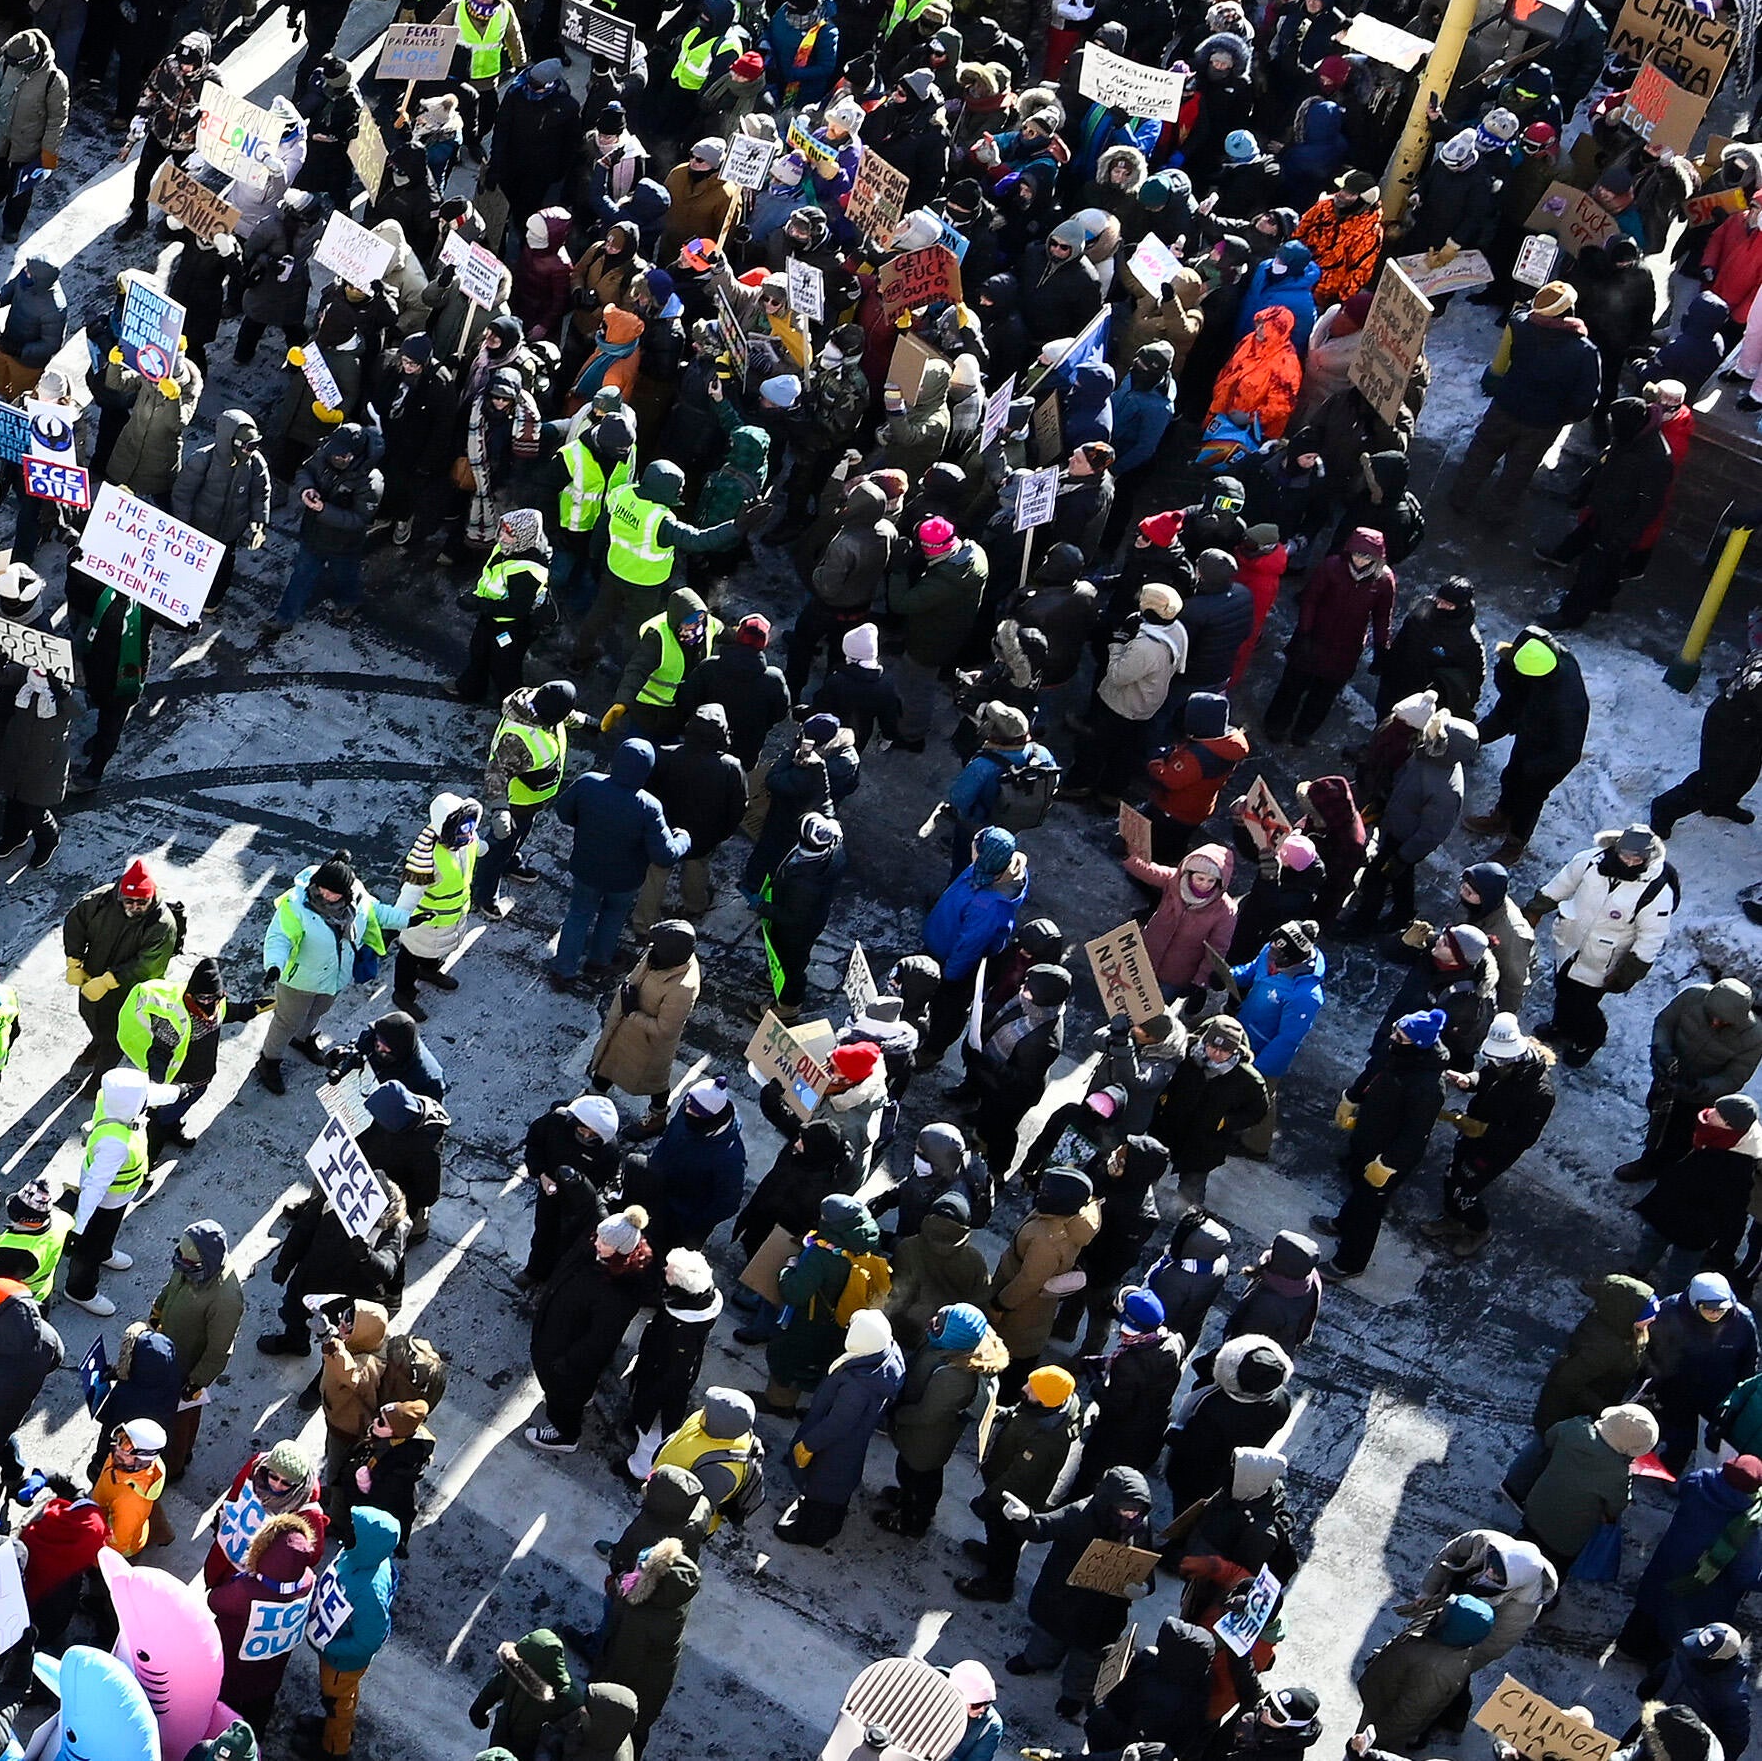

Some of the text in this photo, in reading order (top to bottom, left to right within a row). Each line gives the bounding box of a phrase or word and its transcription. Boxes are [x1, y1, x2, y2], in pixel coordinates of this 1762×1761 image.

[406, 26, 437, 37] FEAR
[392, 49, 439, 62] HOPE
[1614, 35, 1713, 97] MIGRA
[29, 462, 85, 488] ICE
[28, 477, 86, 505] OUT
[105, 510, 211, 571] PLACE TO BE
[118, 496, 216, 556] THE SAFEST
[120, 550, 172, 585] IN THE
[142, 545, 158, 561] IS
[86, 553, 192, 615] EPSTEIN FILES
